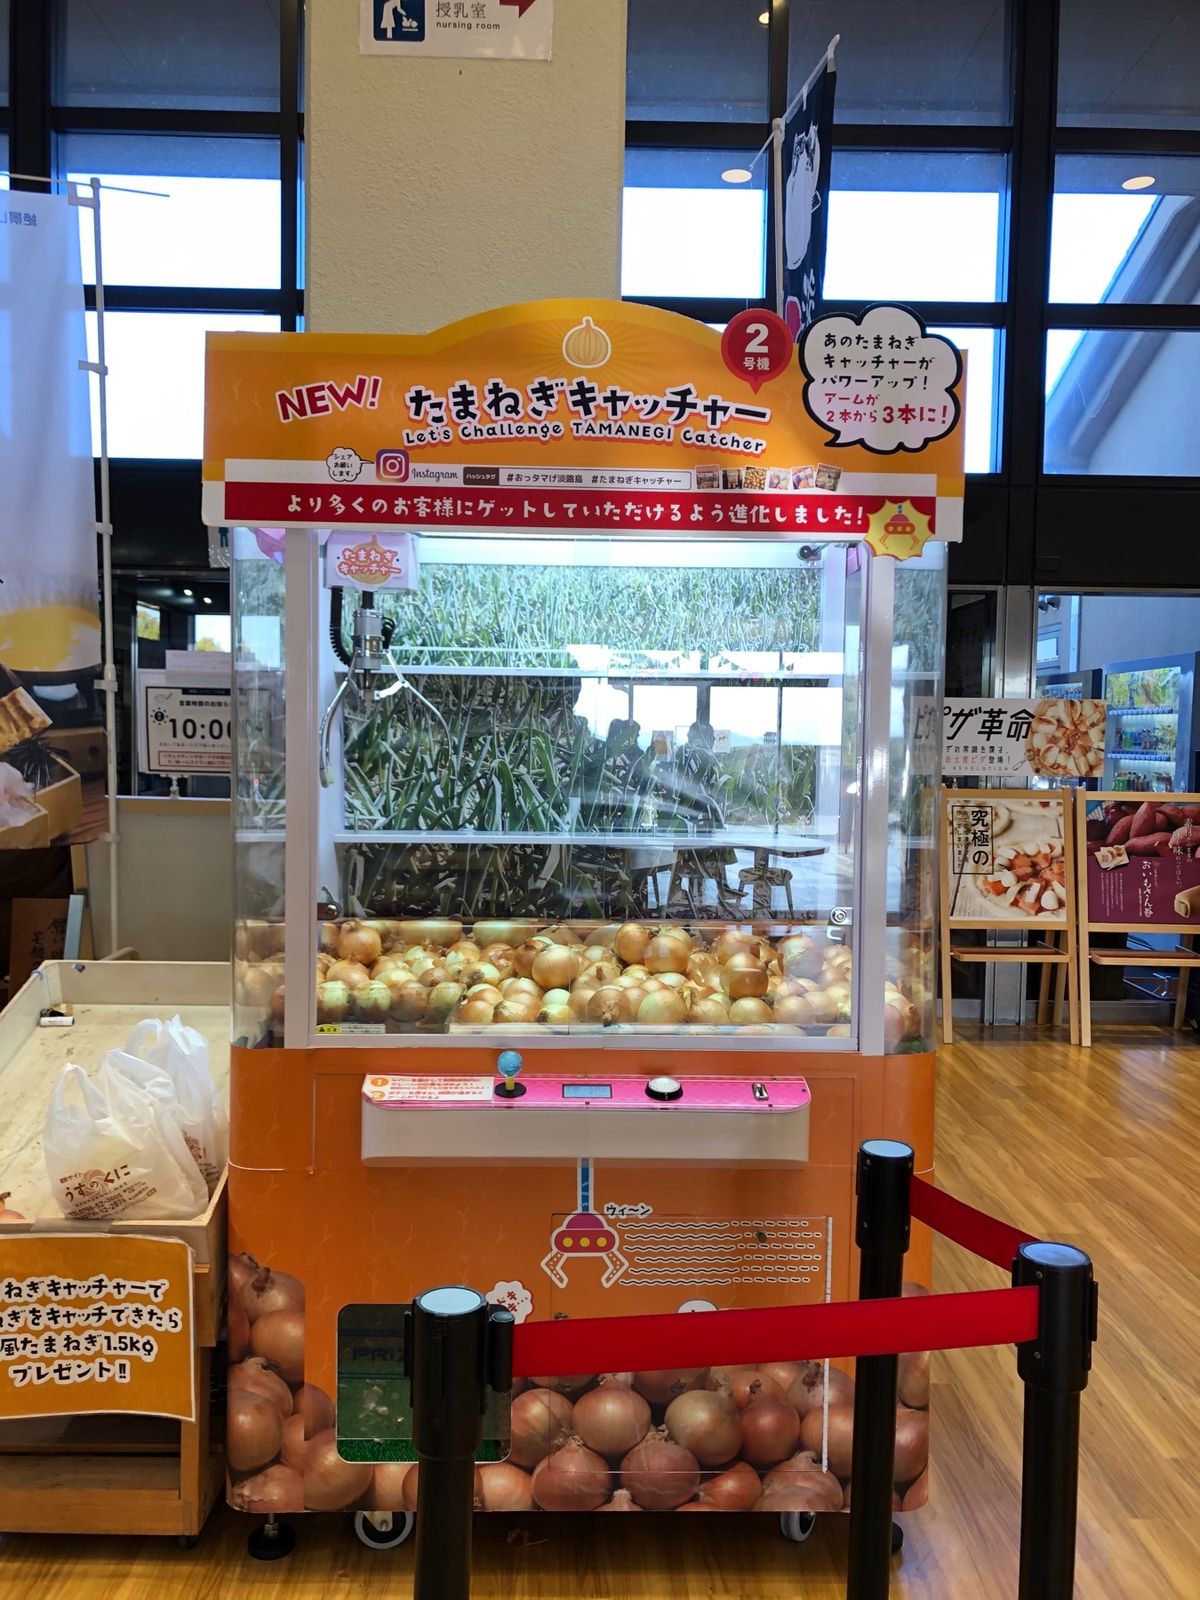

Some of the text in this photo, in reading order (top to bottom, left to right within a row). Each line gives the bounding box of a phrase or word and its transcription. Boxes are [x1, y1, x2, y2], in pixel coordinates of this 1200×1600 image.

[436, 1, 486, 19] 授乳室
[436, 22, 472, 30] nursing
[745, 323, 769, 353] 2
[824, 333, 919, 350] あのたまねぎ
[743, 356, 770, 371] 号機
[824, 354, 935, 370] キャッチャーが
[822, 375, 927, 390] パワーアップ!
[278, 377, 380, 421] NEW!
[409, 380, 767, 426] たまねぎキャッチャー
[825, 392, 880, 406] アームが
[826, 403, 947, 424] 2本から3本に!
[406, 422, 764, 452] Let's Challenge TAMANEGI Catcher
[411, 468, 458, 482] Instagram
[506, 473, 682, 486] #おっタマげ淡路島 #たまねぎキャッチャー
[288, 493, 864, 526] より多くのお客様にゲットしていただけるよう進化しました!
[342, 549, 397, 563] たまねぎ
[339, 561, 401, 574] キャッチャー
[169, 718, 231, 740] 10:0
[971, 810, 989, 866] 究極の
[4, 1278, 166, 1298] ねぎキャッチャーで
[0, 1306, 179, 1328] ぎをキャッチできたら
